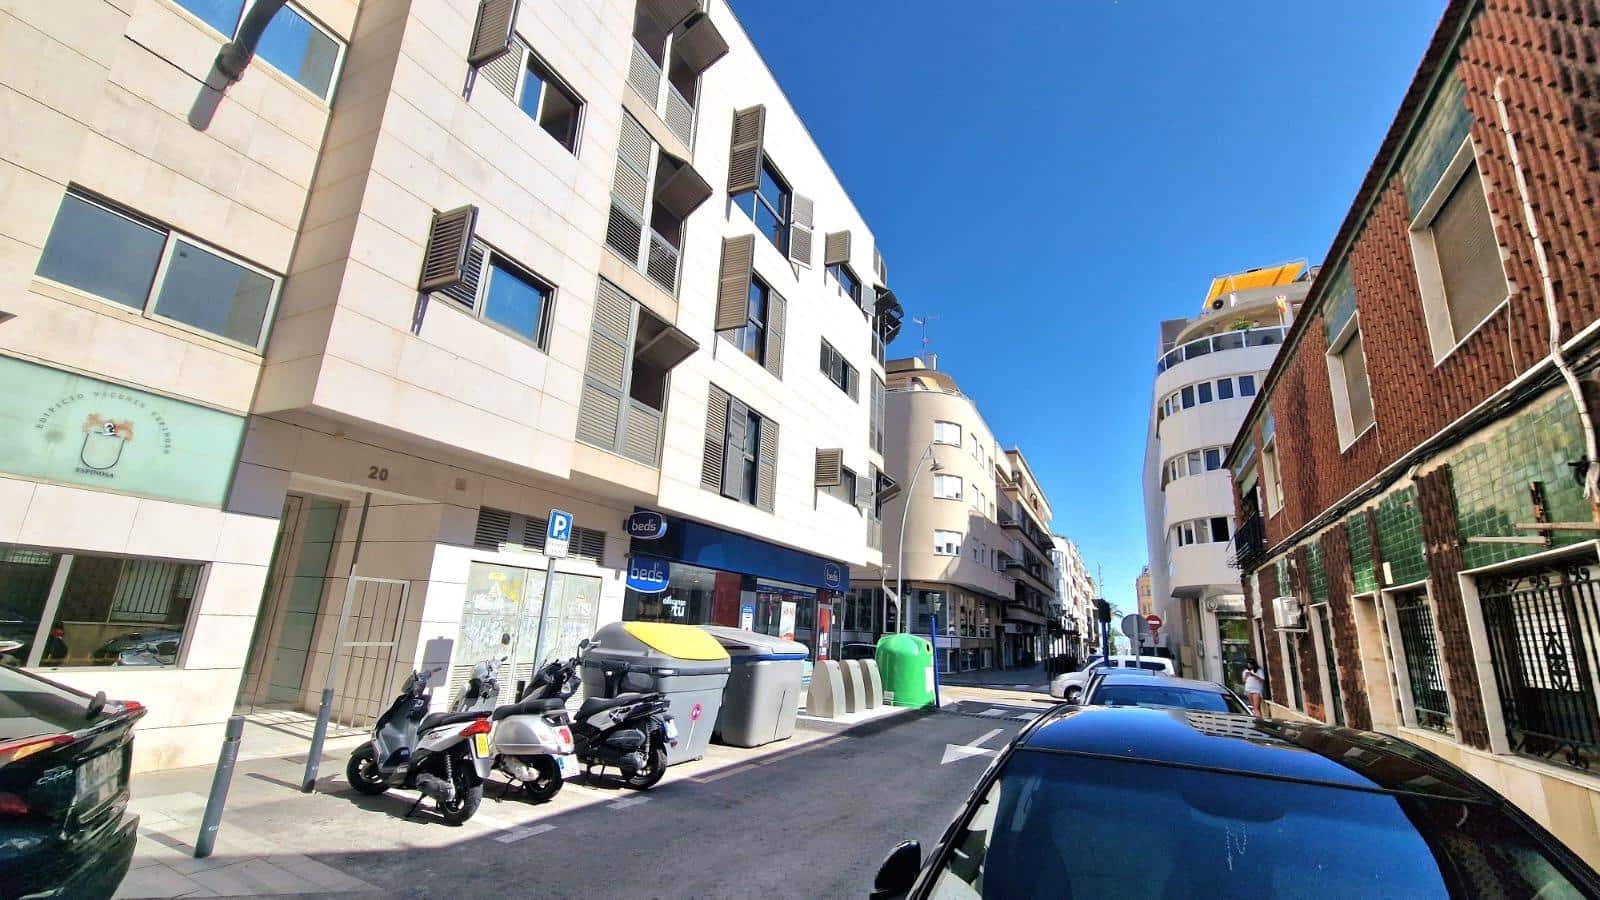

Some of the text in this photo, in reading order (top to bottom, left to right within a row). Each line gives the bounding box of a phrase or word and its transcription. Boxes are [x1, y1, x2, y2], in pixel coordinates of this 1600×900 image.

[74, 467, 114, 479] ESPINOSA
[367, 465, 389, 481] 20
[552, 514, 568, 538] P
